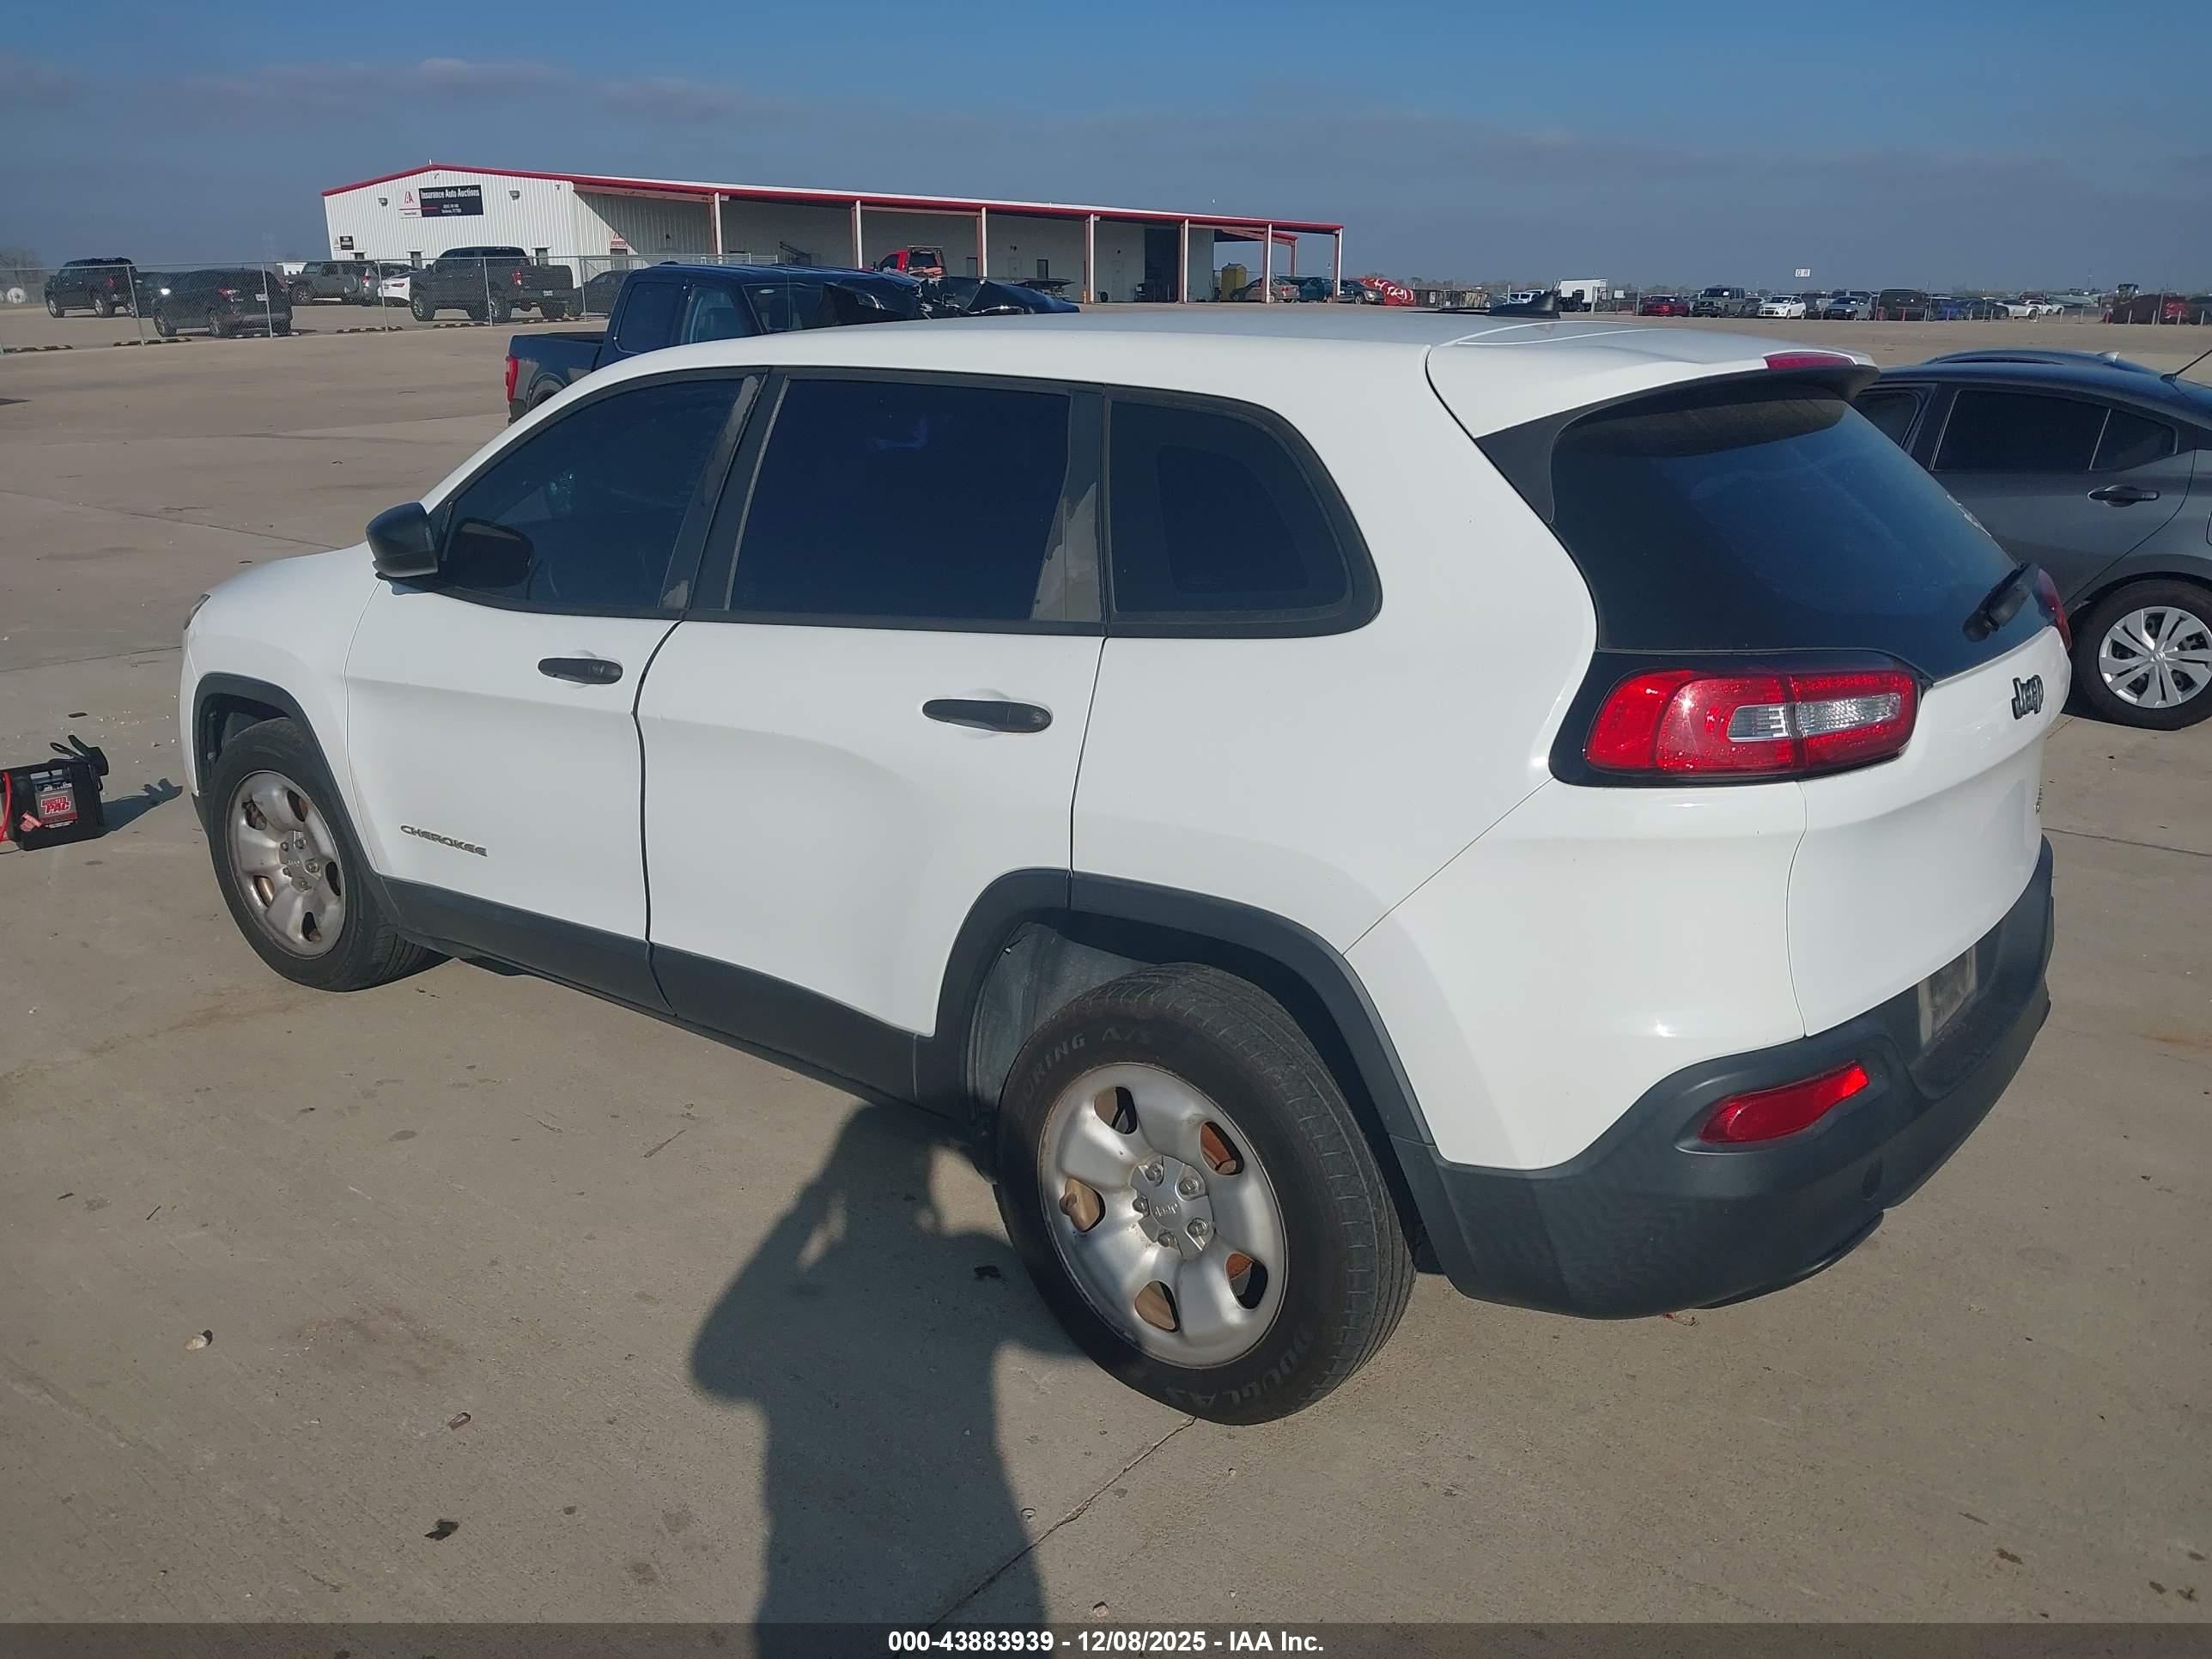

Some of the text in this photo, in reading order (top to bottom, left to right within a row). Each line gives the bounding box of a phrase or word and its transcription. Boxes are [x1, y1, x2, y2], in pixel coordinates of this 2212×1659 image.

[420, 186, 480, 199] Insurance Auto Auctions
[2011, 674, 2045, 720] Jeep
[400, 824, 488, 857] CHEROKEE
